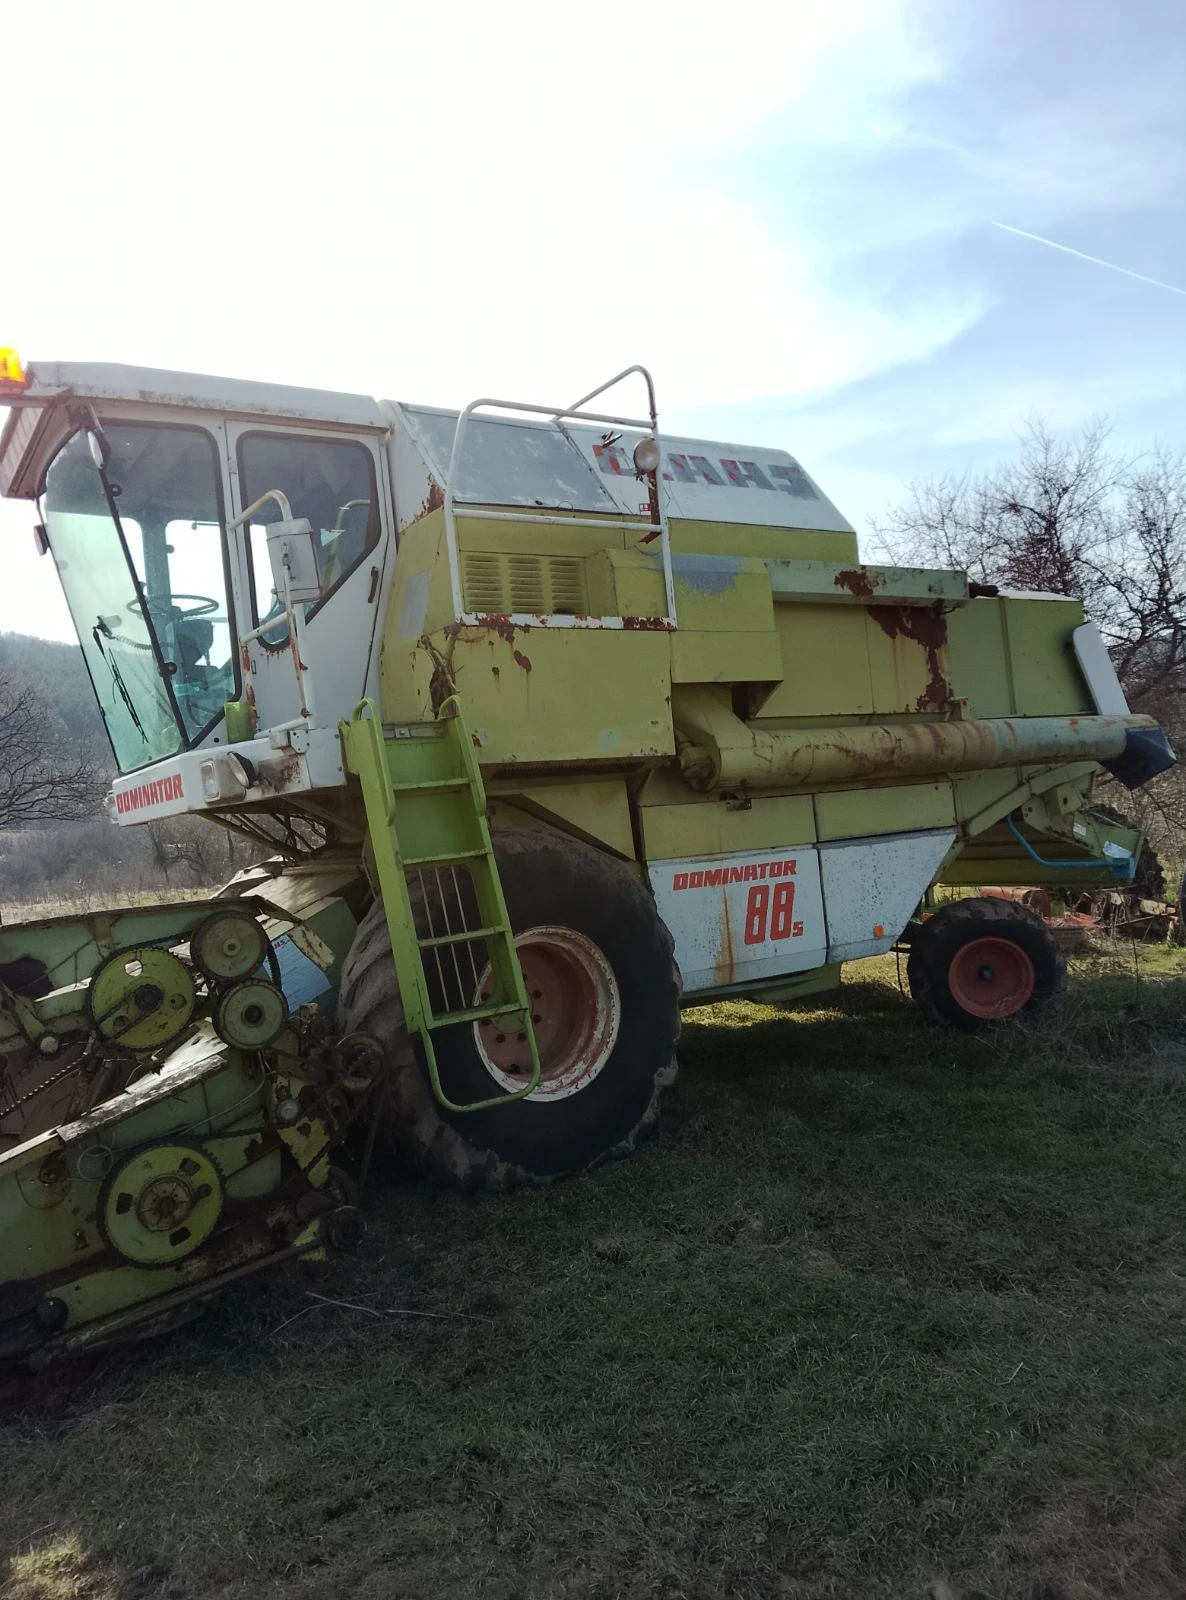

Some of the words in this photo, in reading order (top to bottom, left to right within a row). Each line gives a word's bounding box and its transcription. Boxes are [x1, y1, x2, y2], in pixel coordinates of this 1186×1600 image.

[592, 444, 820, 500] CAAS
[116, 773, 184, 814] DOMINATOR
[673, 860, 797, 891] DOMINATOR
